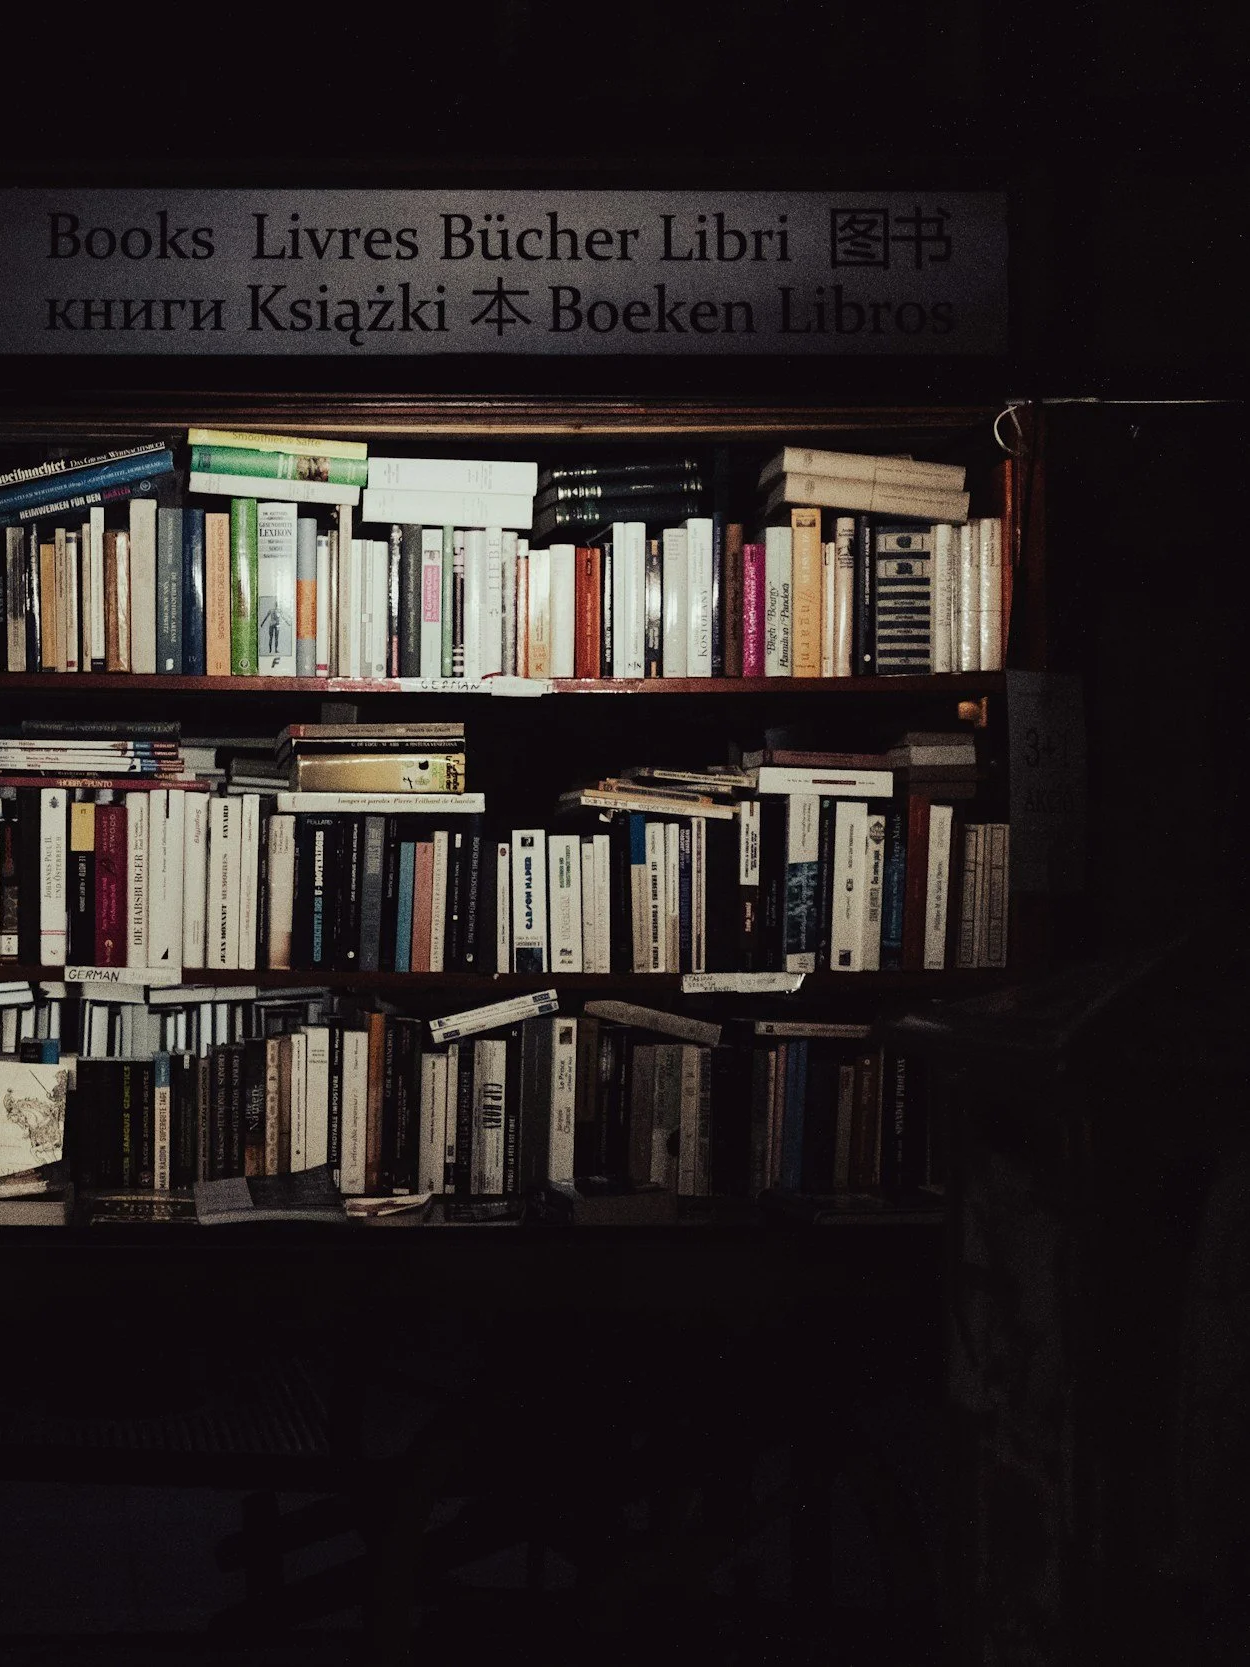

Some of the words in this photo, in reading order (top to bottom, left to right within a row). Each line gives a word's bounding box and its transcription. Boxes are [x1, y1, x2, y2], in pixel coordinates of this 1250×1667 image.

[46, 213, 214, 261] Books
[251, 213, 419, 262] Livres
[440, 211, 639, 262] Bücher
[660, 213, 790, 263] Libri
[830, 206, 951, 271] 图书
[44, 296, 226, 332] книги
[246, 284, 449, 346] Książki
[471, 288, 531, 336] 本
[549, 283, 756, 333] Boeken
[778, 285, 951, 335] Libros
[19, 502, 69, 521] HEIMWERKEN
[71, 497, 85, 508] FÜR
[86, 493, 101, 504] DEN
[259, 528, 293, 537] LEXIKON
[217, 574, 225, 590] DES
[489, 539, 500, 590] LIEBE
[217, 591, 225, 639] SIGNATUREN
[698, 589, 708, 657] KOSTOLANY
[780, 628, 790, 668] Hamilton
[133, 854, 143, 924] HABSBURGER
[133, 927, 143, 946] DIE
[468, 915, 476, 931] HAUS
[68, 969, 120, 982] GERMAN
[158, 1145, 166, 1170] HADDON
